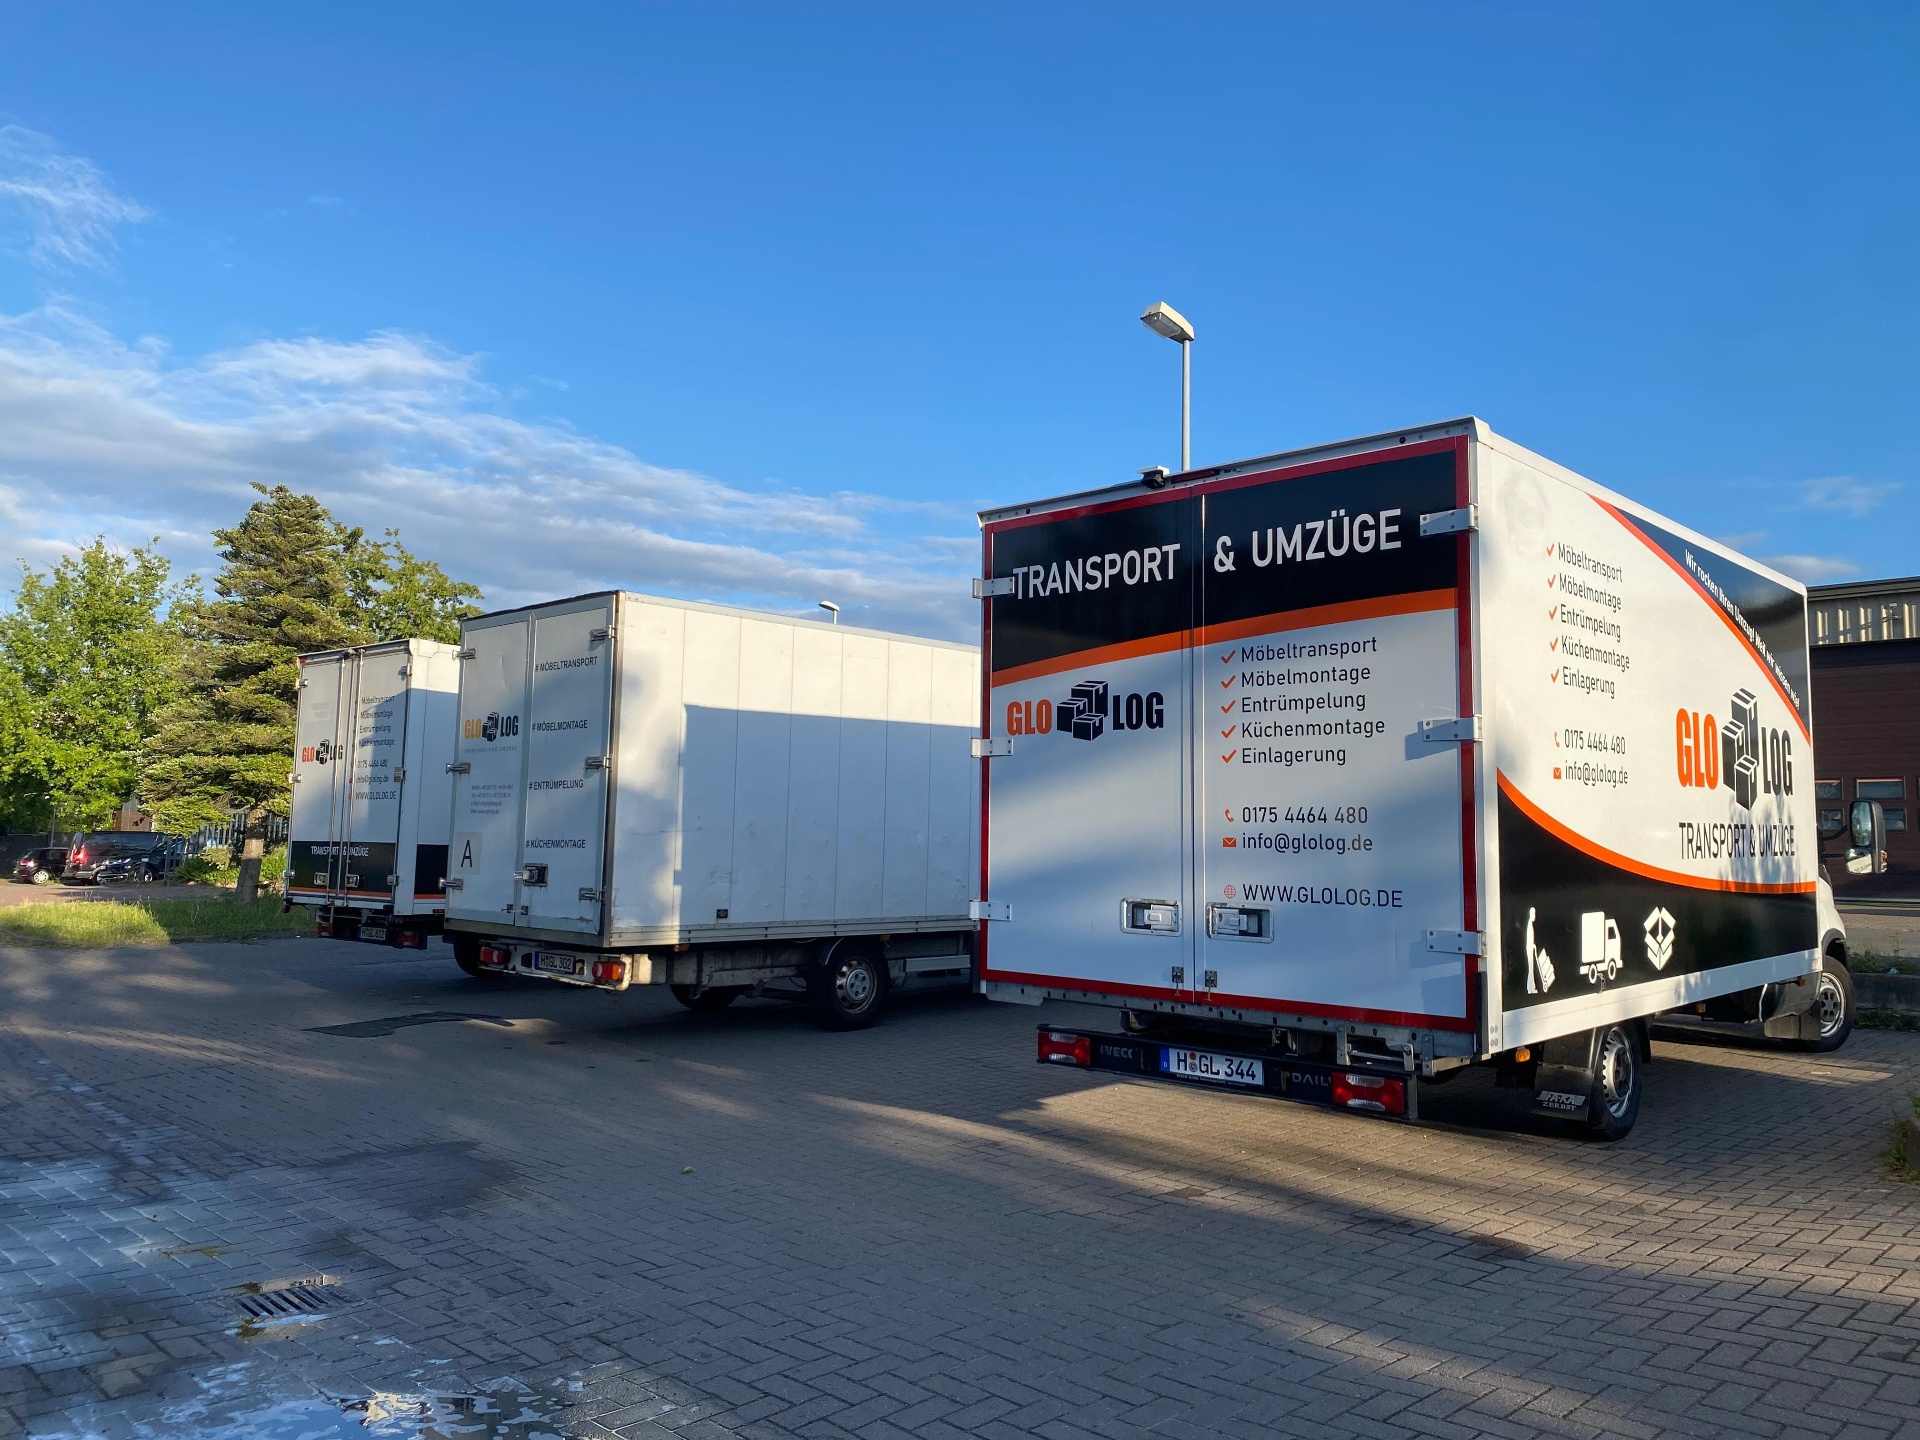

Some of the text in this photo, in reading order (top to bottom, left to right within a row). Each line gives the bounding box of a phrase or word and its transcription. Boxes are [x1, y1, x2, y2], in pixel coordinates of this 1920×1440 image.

[1013, 509, 1402, 600] TRANSPORT & UMZÜGE
[1558, 541, 1623, 583] Möbeltransport
[1559, 572, 1622, 613] Möbelmontage
[1685, 549, 1697, 573] Wir
[1697, 566, 1719, 598] rocken
[1719, 587, 1734, 616] Ihren
[1734, 605, 1754, 643] Umzug!
[1560, 604, 1621, 643] Entrümpelung
[1241, 637, 1377, 662] Möbeltransport
[1561, 635, 1630, 673] Küchenmontage
[540, 656, 598, 672] MÖBELTRANSPORT
[1241, 667, 1371, 687] Möbelmontage
[1562, 665, 1615, 699] Einlagerung
[1006, 692, 1164, 736] GLO LOG
[1241, 692, 1366, 714] Entrümpelung
[464, 715, 518, 740] GLO LOG
[536, 720, 588, 732] MÖBELMONTAGE
[1241, 719, 1385, 739] Küchenmontage
[1564, 728, 1626, 755] 0175 4464 480
[1675, 707, 1794, 797] GLO LOG
[302, 747, 314, 762] GLO
[1242, 748, 1346, 767] Einlagerung
[534, 779, 584, 790] ENTRÜMPELUNG
[1565, 760, 1628, 788] info@glolog.de
[356, 790, 397, 800] WWW.GLOLOG.DE
[1242, 807, 1368, 823] 0175 4464 480
[530, 838, 586, 849] KÜCHENMONTAGE
[1242, 833, 1373, 855] info@glolog.de
[1678, 819, 1796, 860] TRANSPORT & UMZÜGE
[460, 840, 473, 868] A
[1242, 884, 1403, 908] WWW.GLOLOG.DE
[559, 957, 572, 970] 302
[1224, 1058, 1256, 1081] 344
